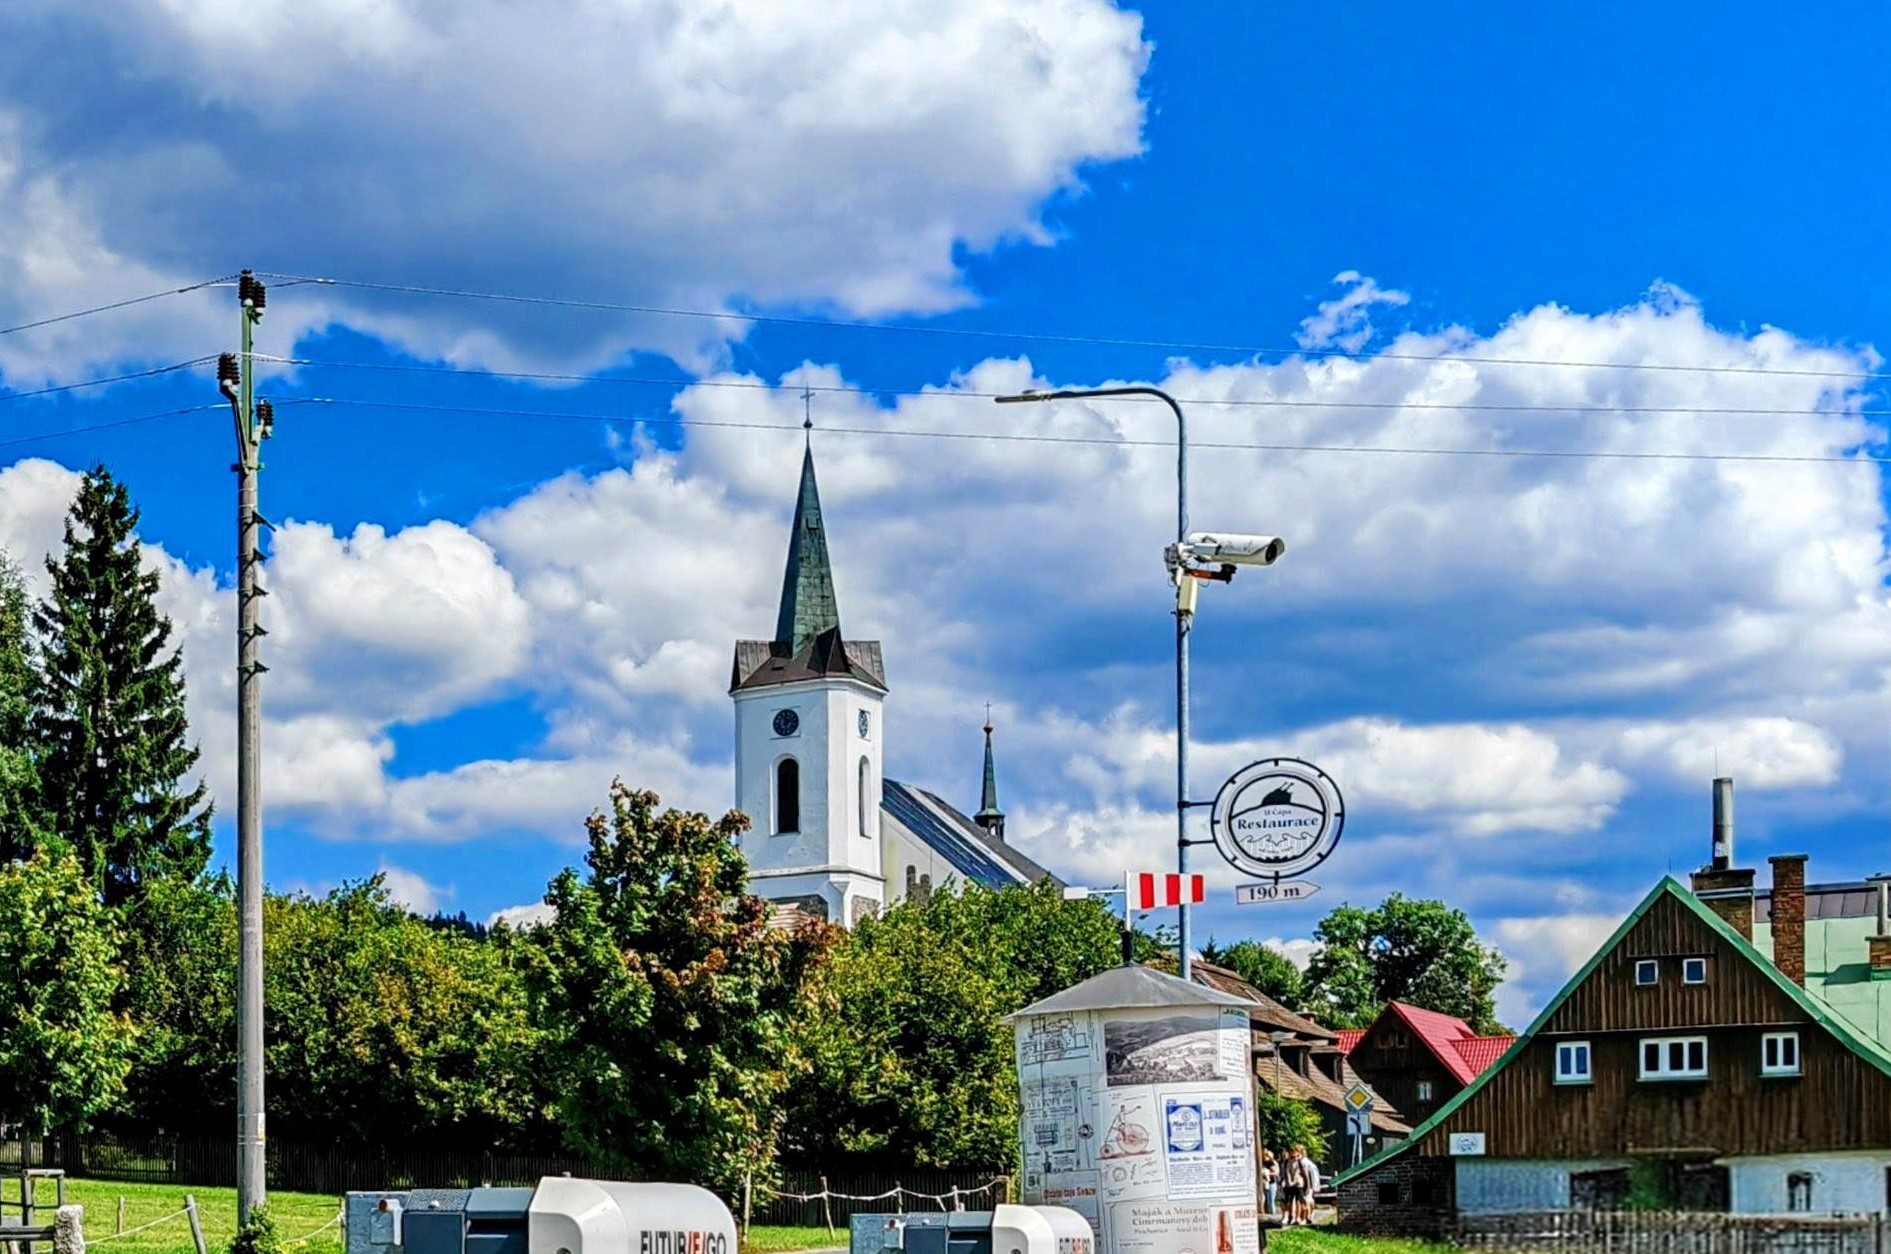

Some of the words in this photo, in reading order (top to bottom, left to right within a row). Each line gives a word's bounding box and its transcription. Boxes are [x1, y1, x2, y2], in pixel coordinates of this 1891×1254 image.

[1238, 816, 1319, 830] Restaurace
[1249, 886, 1278, 900] 190
[1284, 887, 1300, 897] m
